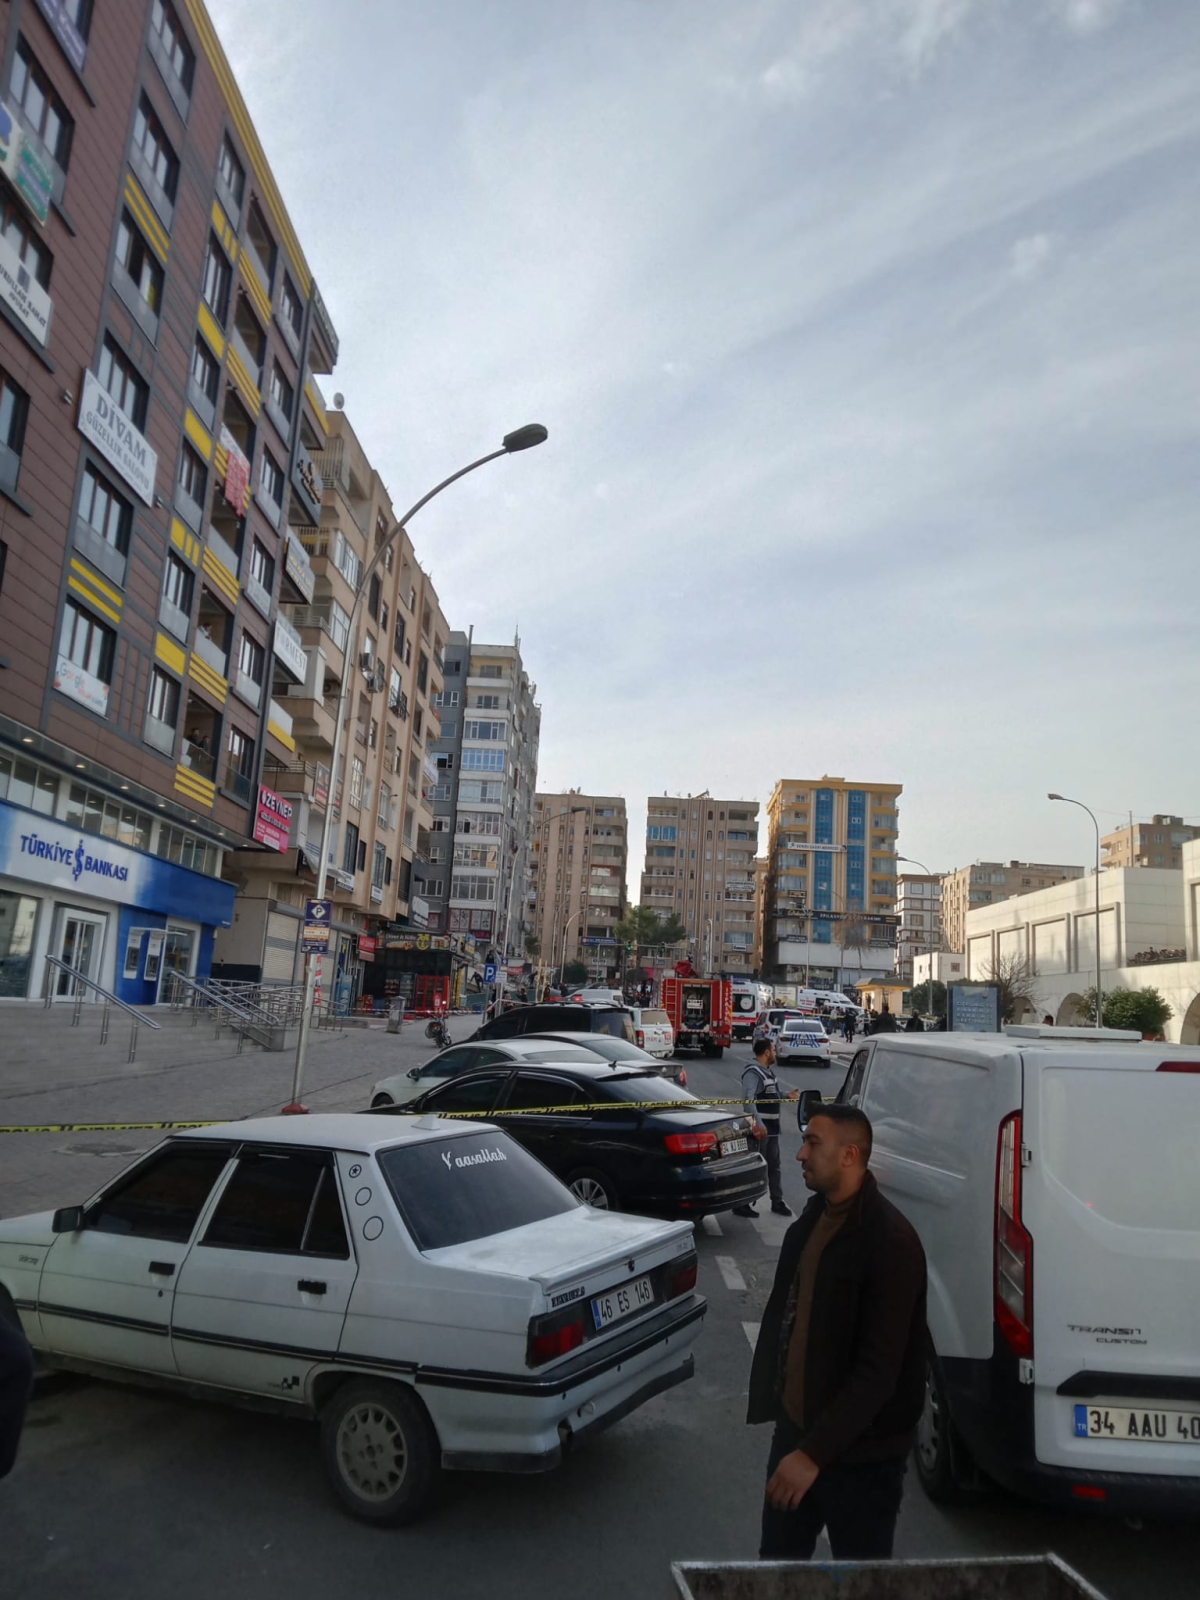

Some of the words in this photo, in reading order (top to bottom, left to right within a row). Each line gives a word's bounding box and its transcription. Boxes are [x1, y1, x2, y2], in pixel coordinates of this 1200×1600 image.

[96, 393, 147, 468] DİVAM
[21, 833, 73, 867] TÜRKİYE
[84, 856, 129, 881] BANKASI
[316, 907, 322, 915] P
[486, 967, 494, 981] P
[601, 1299, 613, 1321] 46
[617, 1290, 631, 1313] ES
[635, 1281, 651, 1304] 146
[1096, 1337, 1148, 1345] CUSTOM
[1078, 1423, 1087, 1431] TR
[1089, 1410, 1115, 1435] 34
[1127, 1412, 1167, 1438] AAU
[1177, 1415, 1200, 1439] 40
